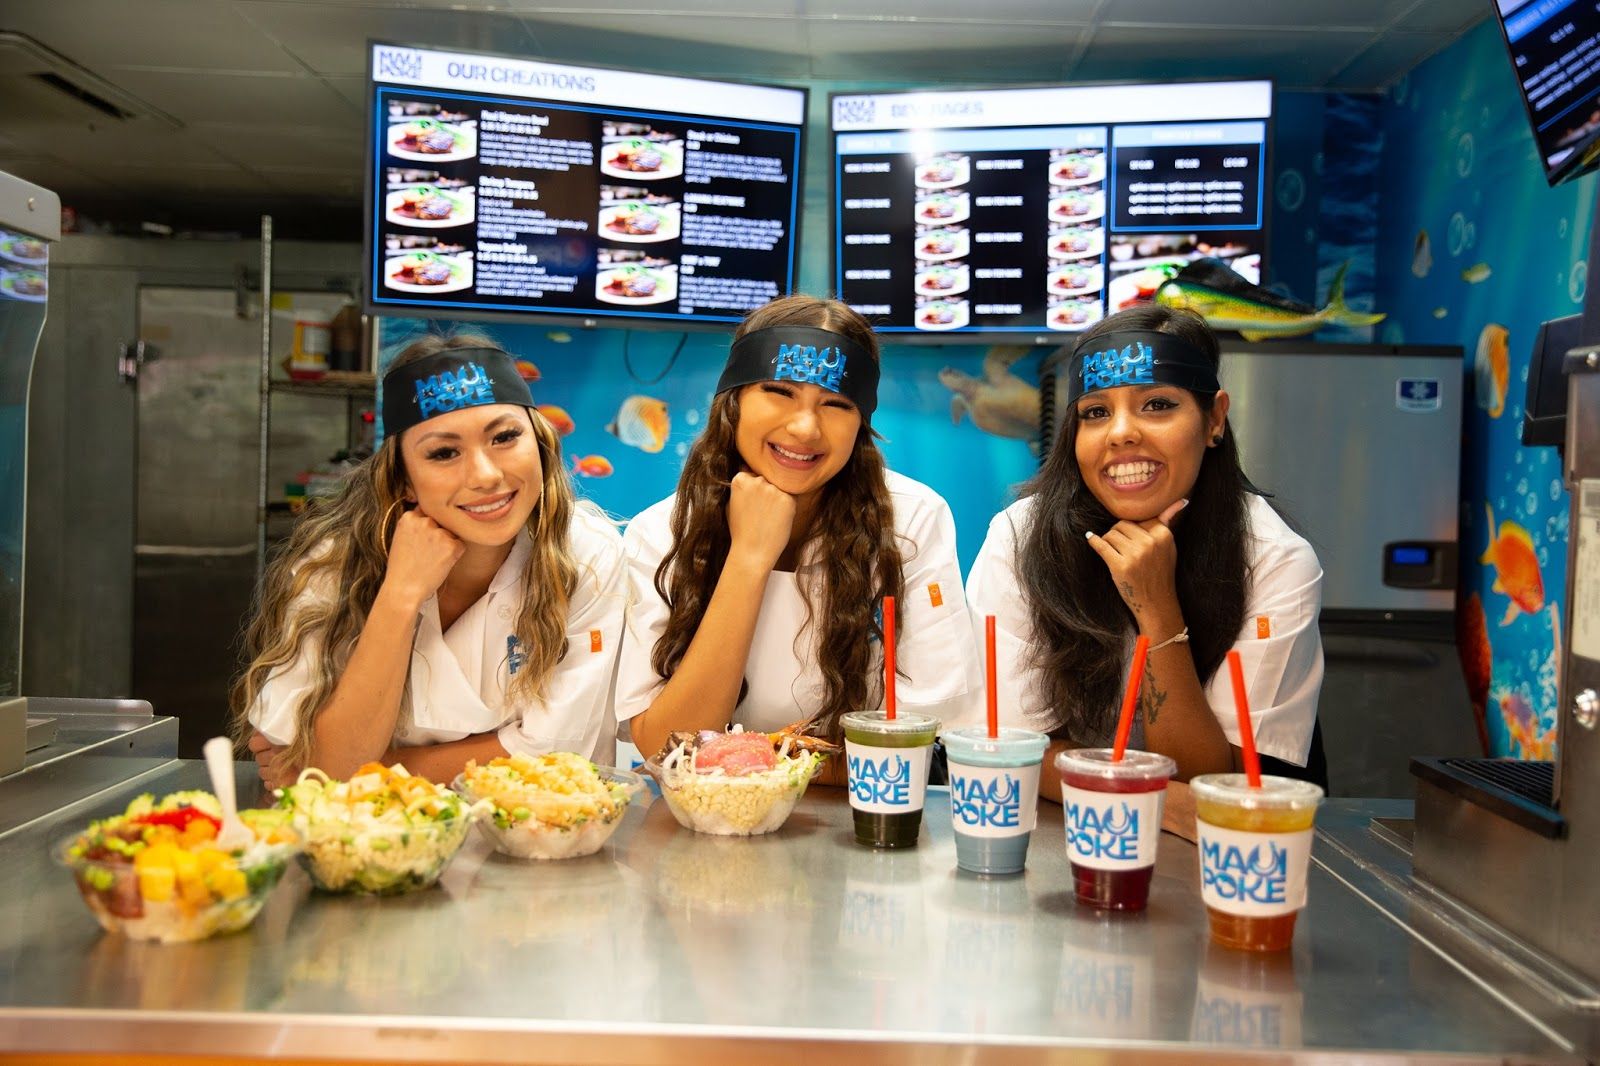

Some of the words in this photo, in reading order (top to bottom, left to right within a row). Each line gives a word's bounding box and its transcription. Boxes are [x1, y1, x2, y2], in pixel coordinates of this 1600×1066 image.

[447, 62, 487, 80] OUR
[490, 66, 596, 92] CREATIONS
[891, 101, 984, 118] BEVRAGES
[777, 343, 848, 370] MAUI
[1082, 341, 1153, 371] MAUI
[415, 362, 491, 397] MAUI
[774, 363, 842, 393] POKE
[1083, 364, 1155, 393] POKE
[417, 382, 496, 419] POKE
[848, 754, 910, 783] MAUI
[848, 777, 910, 805] POKE
[951, 773, 1020, 804] MAUI
[952, 799, 1020, 827] POKE
[1065, 800, 1138, 835] MAUI
[1066, 827, 1138, 860] POKE
[1202, 836, 1287, 876] MAUI
[1203, 866, 1286, 903] POKE
